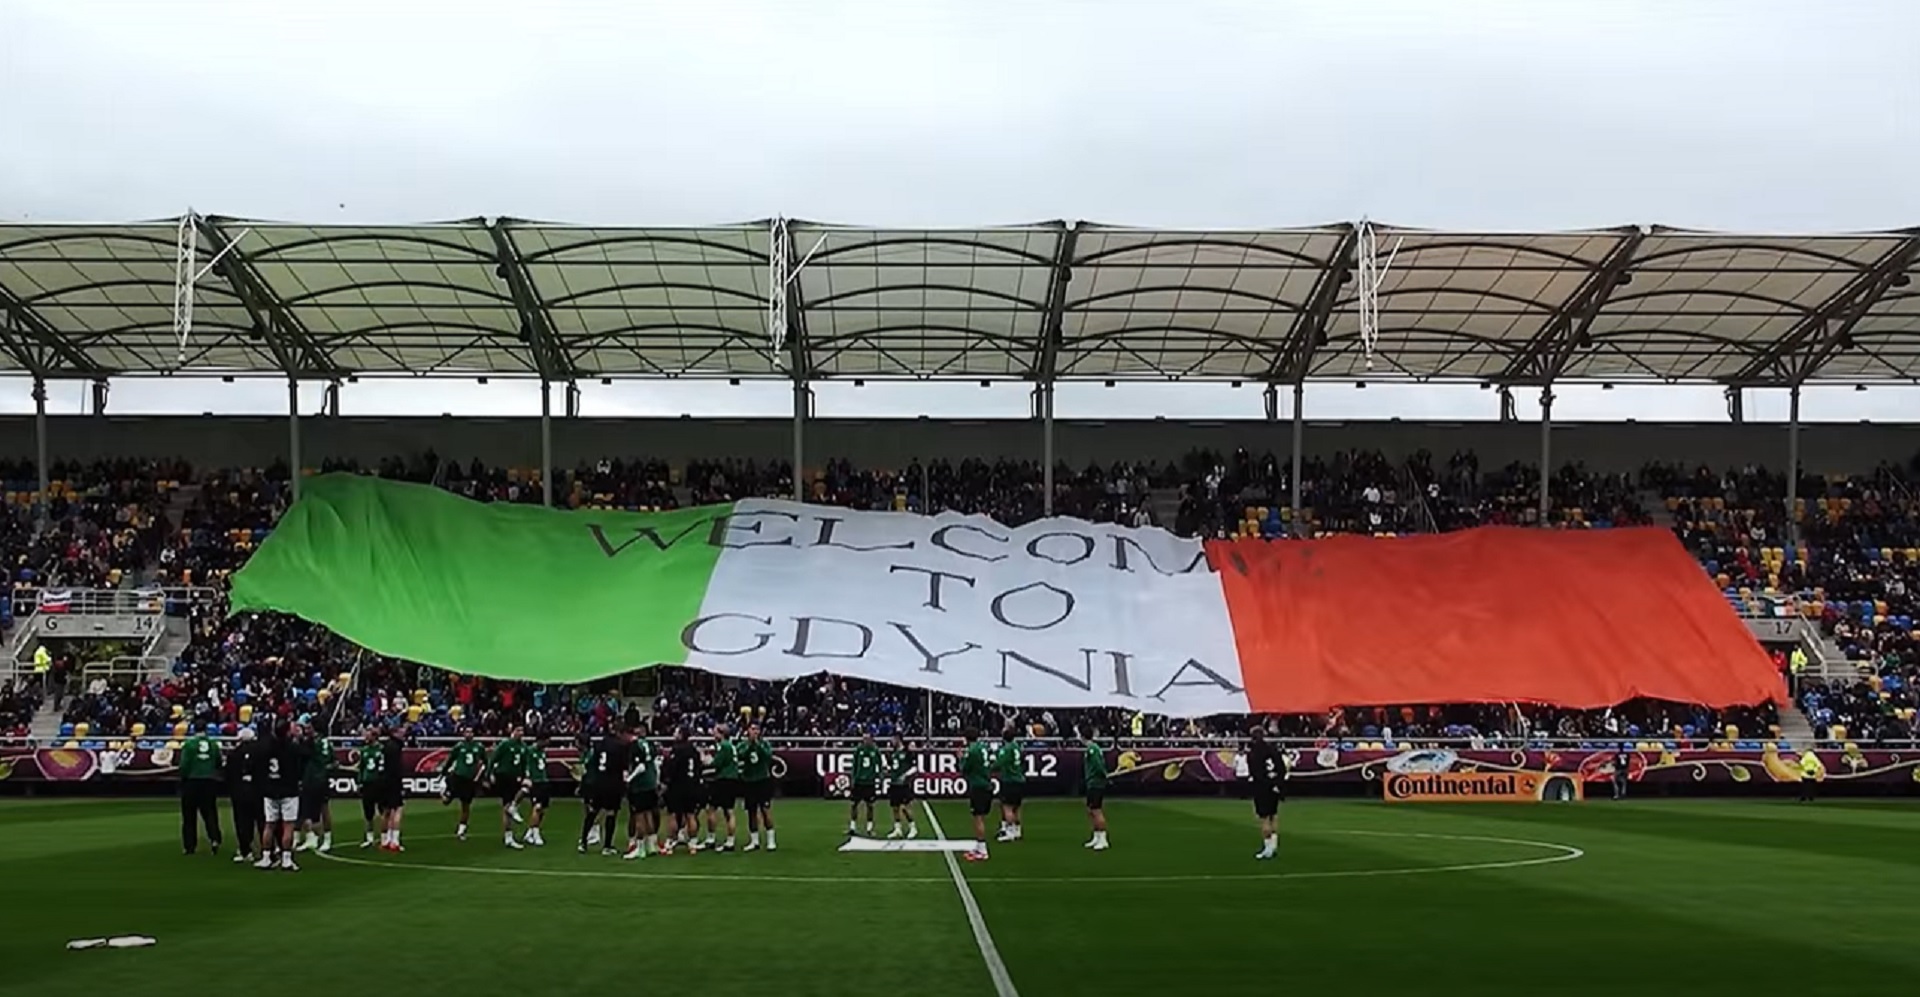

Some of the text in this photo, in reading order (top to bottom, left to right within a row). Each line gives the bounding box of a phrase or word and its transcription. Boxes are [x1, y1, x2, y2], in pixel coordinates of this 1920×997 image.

[586, 510, 1250, 576] WELCOM
[889, 564, 1076, 630] TO
[45, 616, 58, 630] G
[135, 616, 153, 630] 14
[1776, 621, 1793, 635] 17
[680, 613, 1246, 702] GDYNIA
[269, 758, 280, 773] 3
[1265, 757, 1275, 771] 3
[913, 778, 968, 794] EURO
[1387, 774, 1516, 798] Continental
